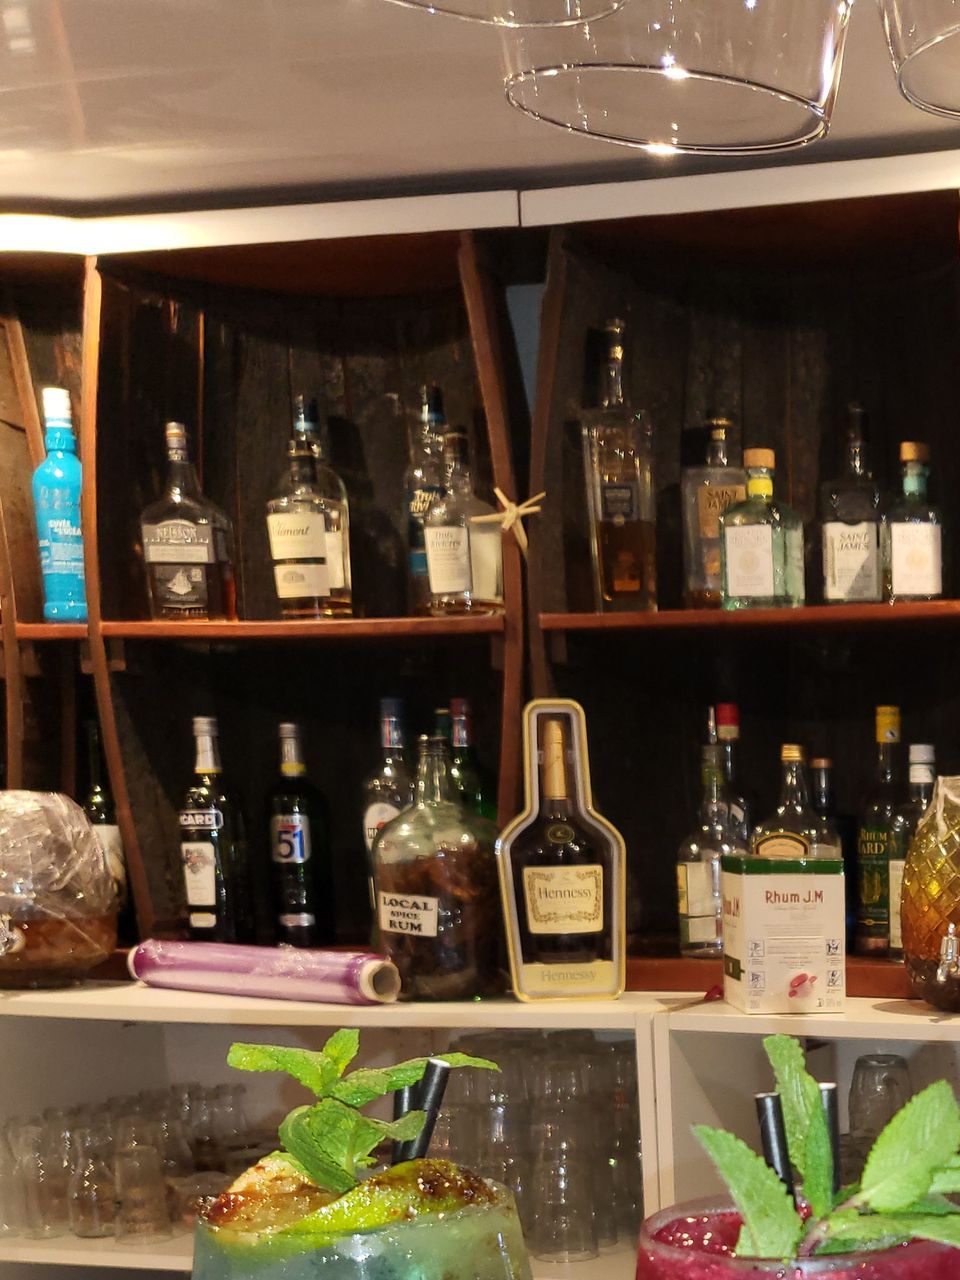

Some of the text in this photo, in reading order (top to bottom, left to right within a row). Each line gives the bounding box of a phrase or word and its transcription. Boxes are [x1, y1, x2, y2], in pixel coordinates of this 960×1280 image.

[277, 829, 306, 859] 51
[538, 886, 593, 901] Hennessy
[764, 889, 825, 905] Rhum J.M
[382, 896, 434, 913] LOCAL
[390, 910, 421, 921] SPICE
[388, 919, 424, 934] RUM
[540, 968, 597, 986] Hennessy
